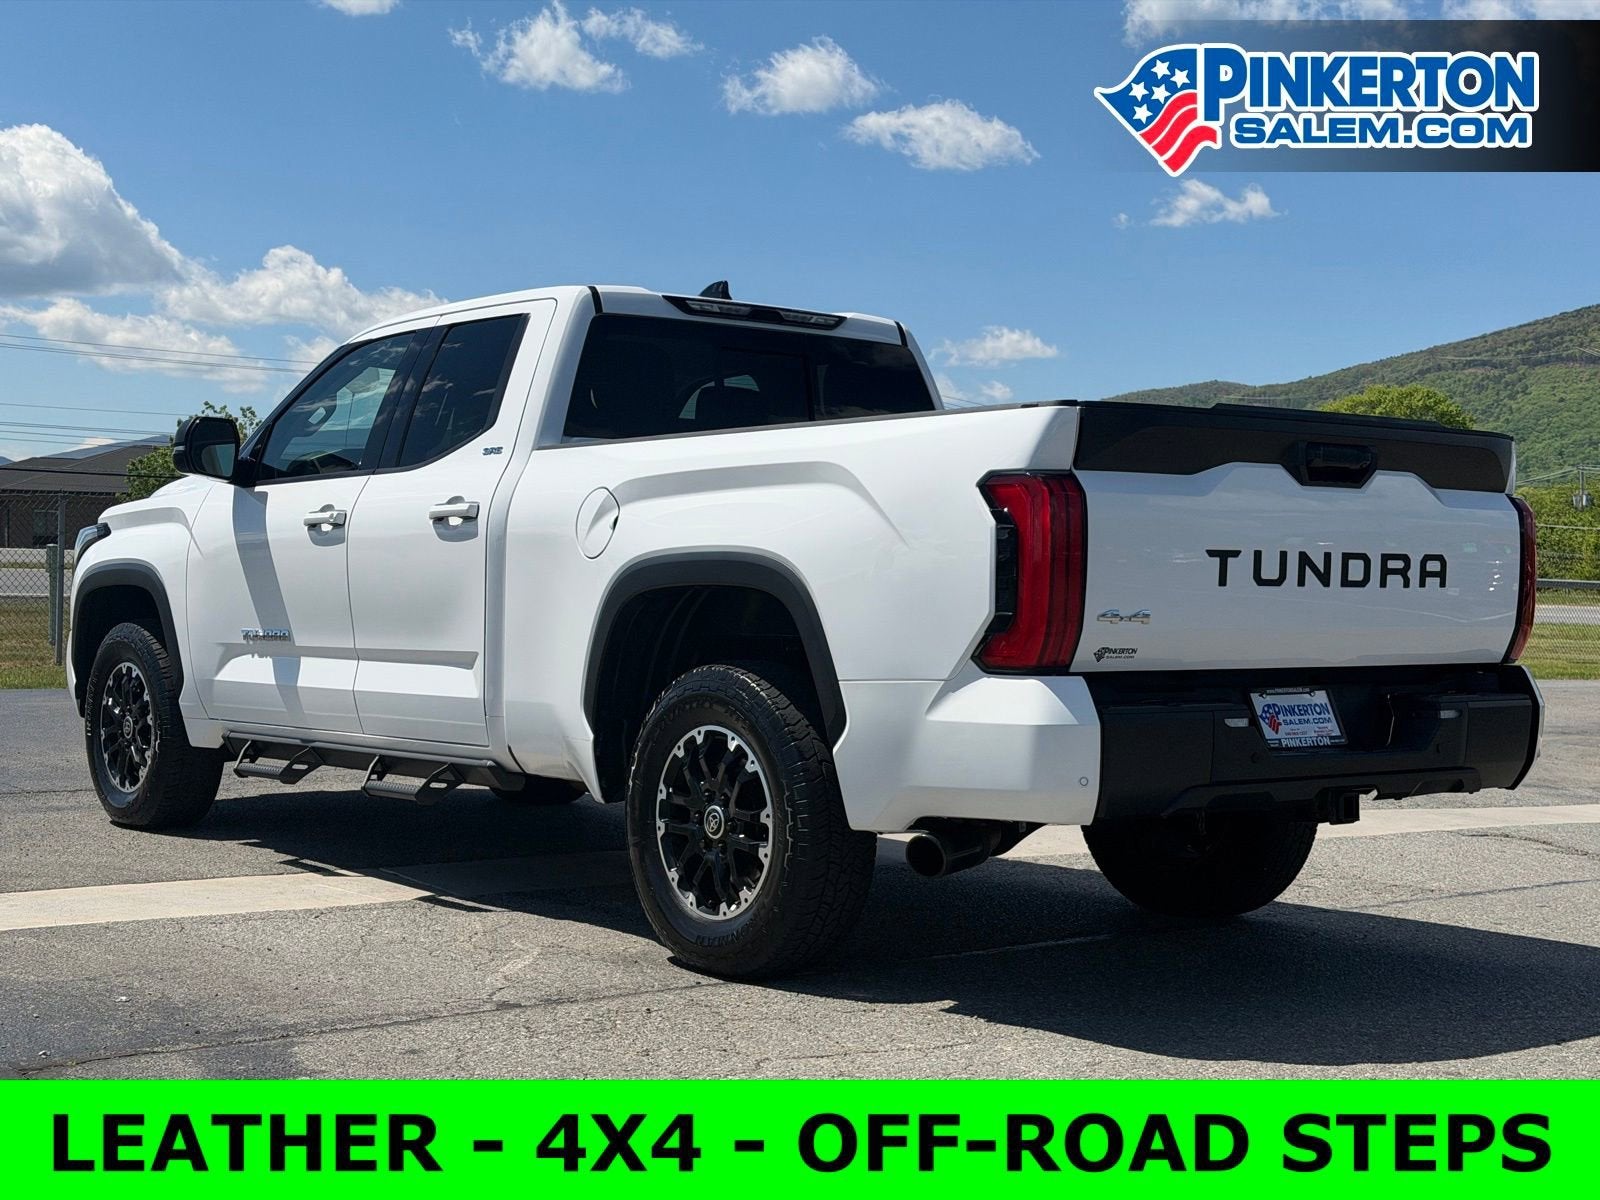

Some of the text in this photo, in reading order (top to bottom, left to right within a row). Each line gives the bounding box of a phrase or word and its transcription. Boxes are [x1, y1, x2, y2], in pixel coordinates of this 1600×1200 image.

[1205, 549, 1447, 588] TUNDRA
[1272, 703, 1331, 719] PINKERTON
[1283, 717, 1332, 726] SALEM.COM
[1281, 736, 1331, 748] PINKERTON
